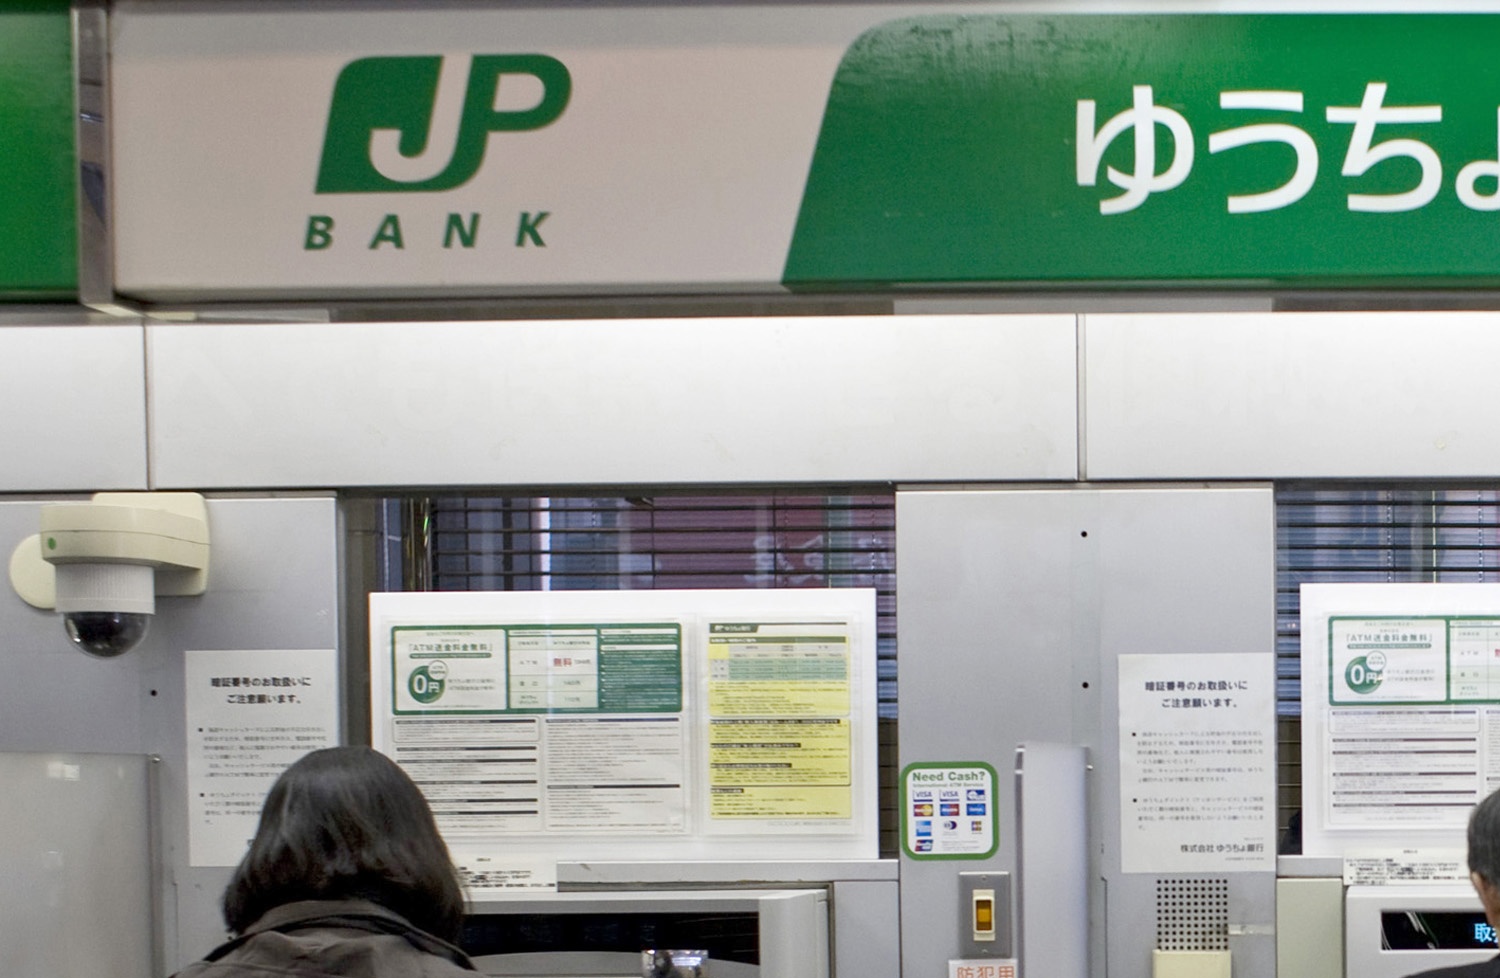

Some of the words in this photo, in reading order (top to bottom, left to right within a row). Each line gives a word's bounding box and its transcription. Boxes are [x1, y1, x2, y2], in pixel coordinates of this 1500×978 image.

[314, 54, 573, 194] JP
[303, 212, 553, 251] BANK
[1346, 634, 1433, 642] 「ATM送金料金無料」
[210, 677, 312, 688] 暗証番号のお取扱いに
[1145, 681, 1248, 692] 暗証番号のお取扱いに
[226, 694, 302, 704] ご注意願います。
[1161, 698, 1238, 708] ご注意願います。
[913, 772, 944, 781] Need
[948, 771, 986, 781] Cash?
[1216, 844, 1264, 853] ゆうちょ銀行
